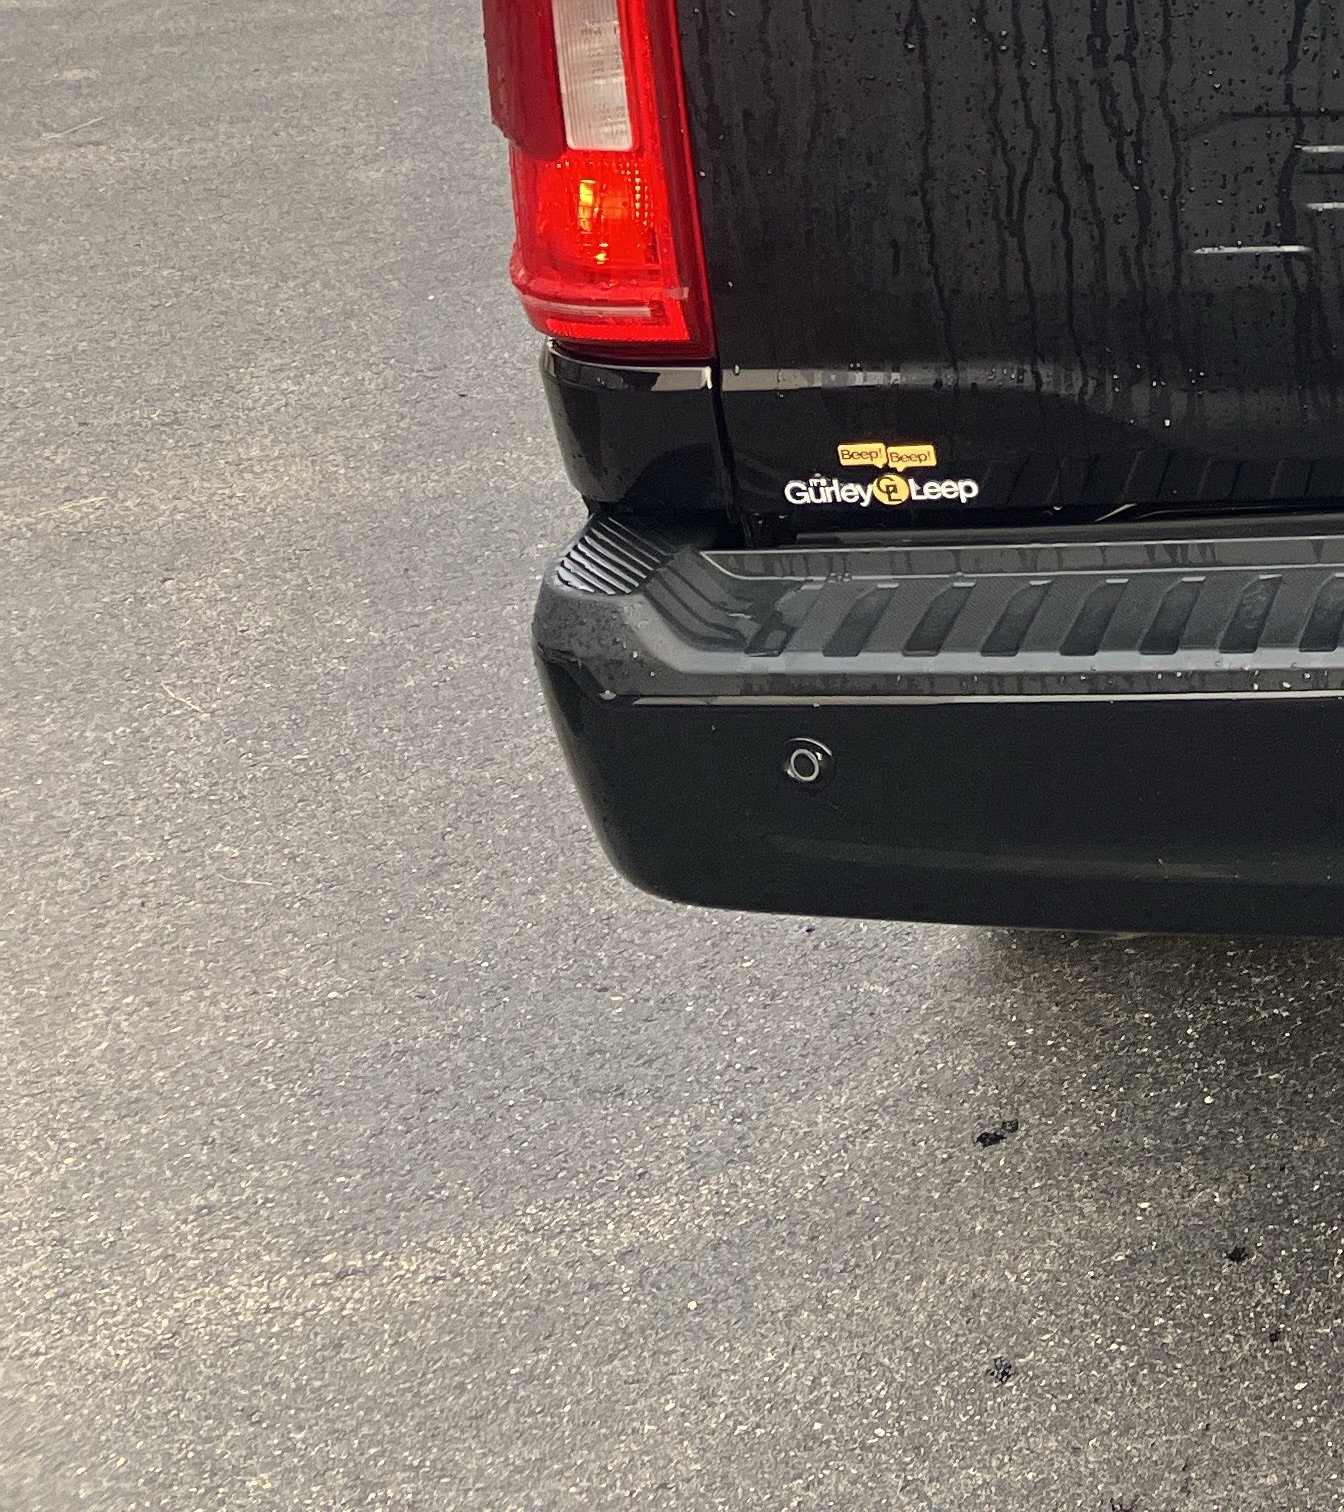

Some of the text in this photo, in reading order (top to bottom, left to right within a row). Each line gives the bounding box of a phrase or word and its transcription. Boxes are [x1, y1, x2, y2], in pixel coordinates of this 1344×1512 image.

[840, 447, 931, 464] Beep! Beep!
[909, 477, 979, 503] Leep
